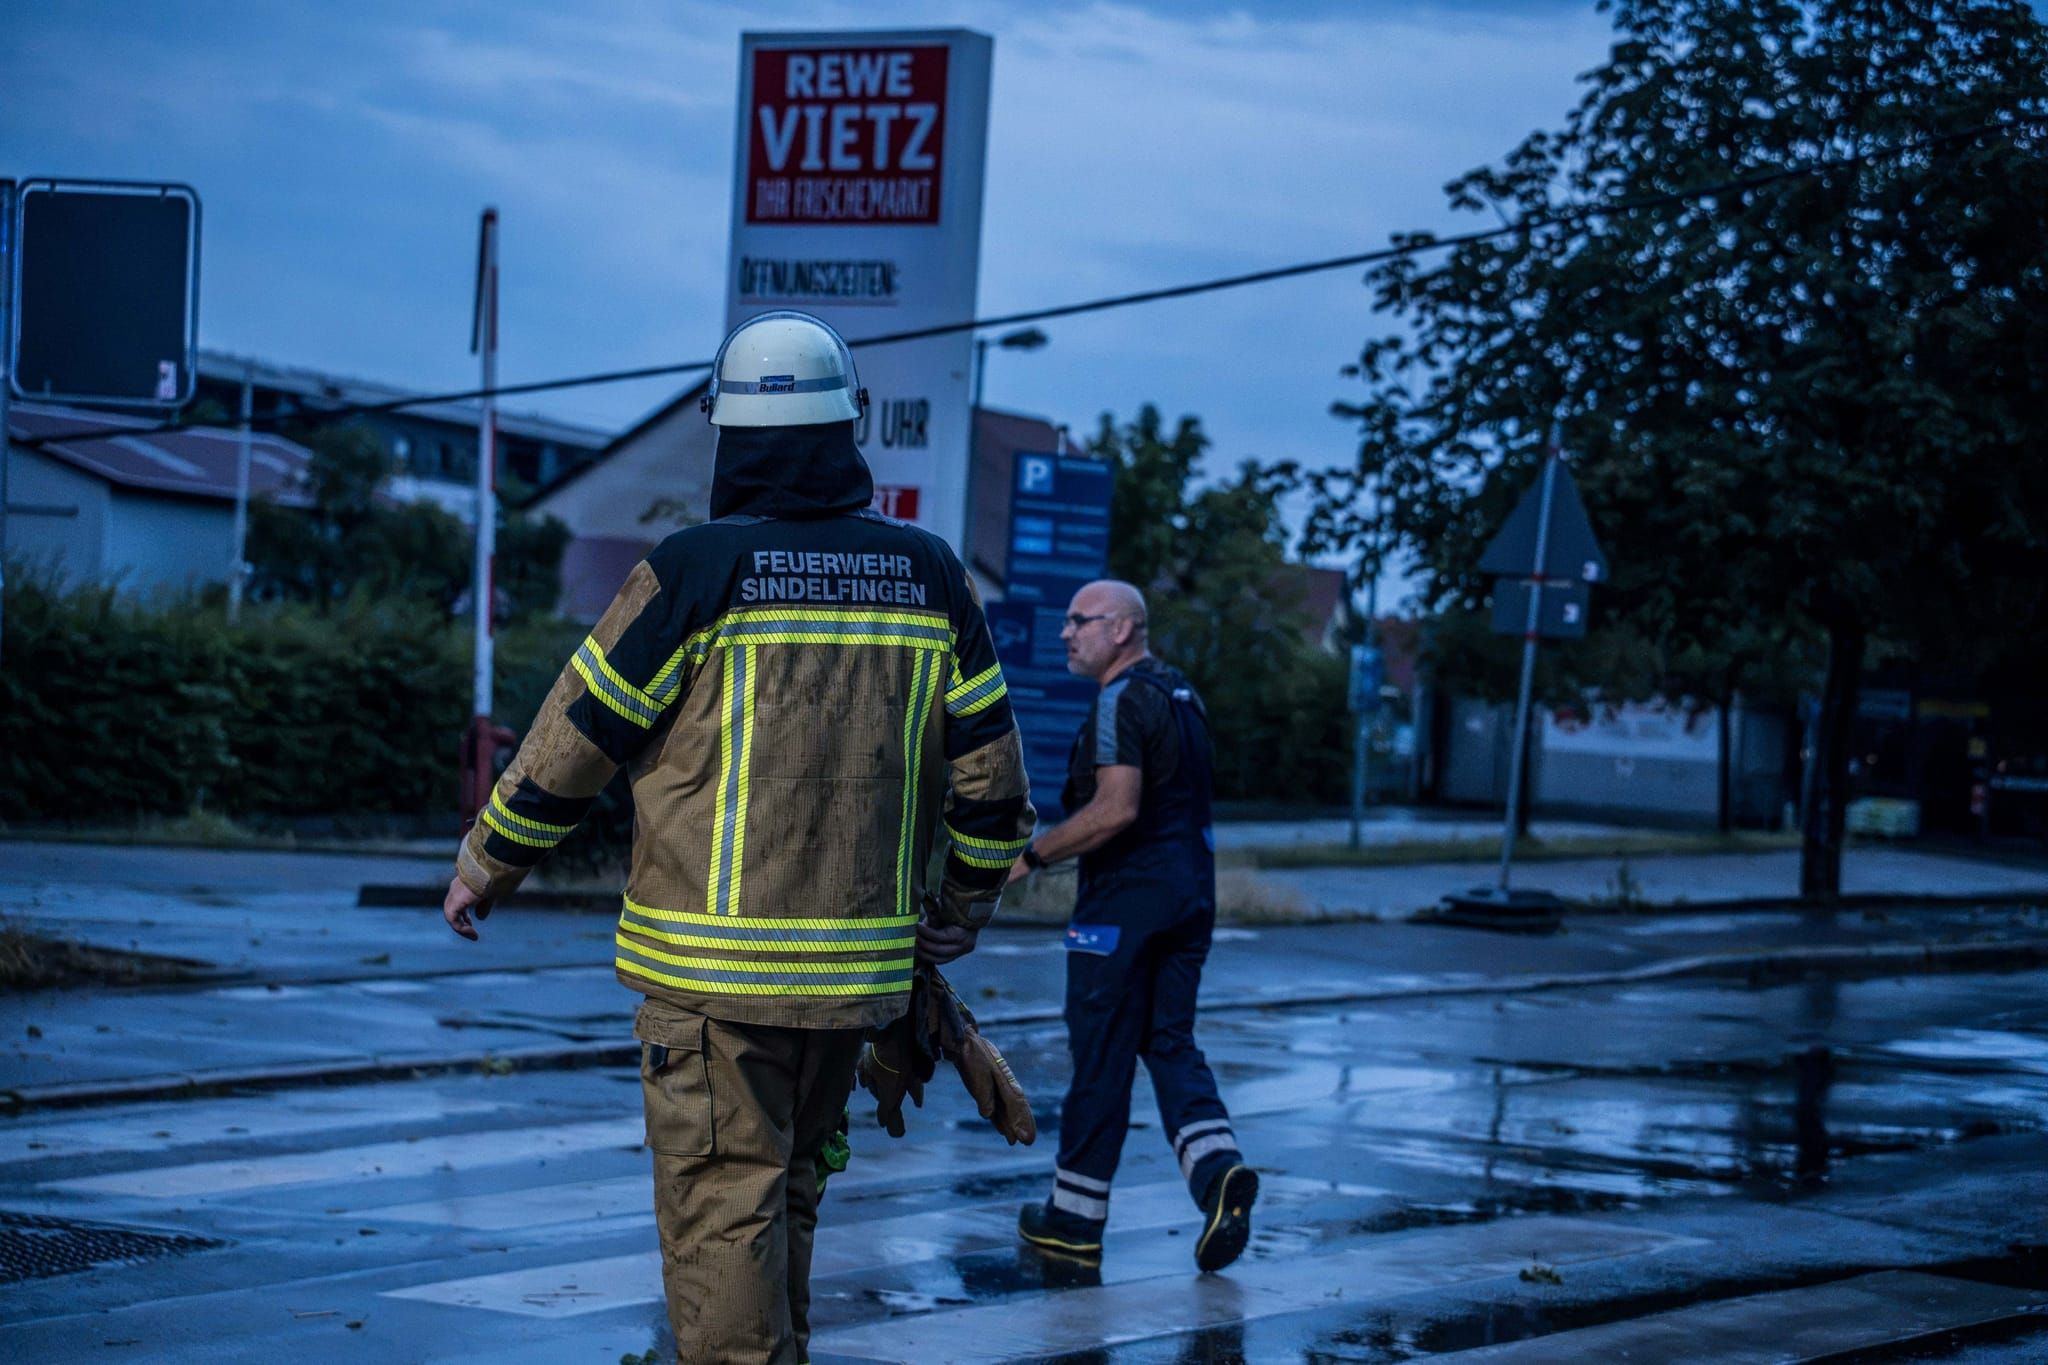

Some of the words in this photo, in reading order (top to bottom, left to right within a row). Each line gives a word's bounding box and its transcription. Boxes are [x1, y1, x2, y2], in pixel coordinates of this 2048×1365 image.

[786, 53, 913, 98] REWE
[758, 103, 938, 171] VIETZ
[755, 177, 790, 218] IHR
[794, 177, 931, 218] FRISCHEMARKT
[759, 382, 795, 392] Bullard
[881, 398, 930, 448] UHR
[1024, 457, 1048, 489] P
[753, 550, 912, 578] FEUERWEHR
[741, 577, 926, 606] SINDELFINGEN
